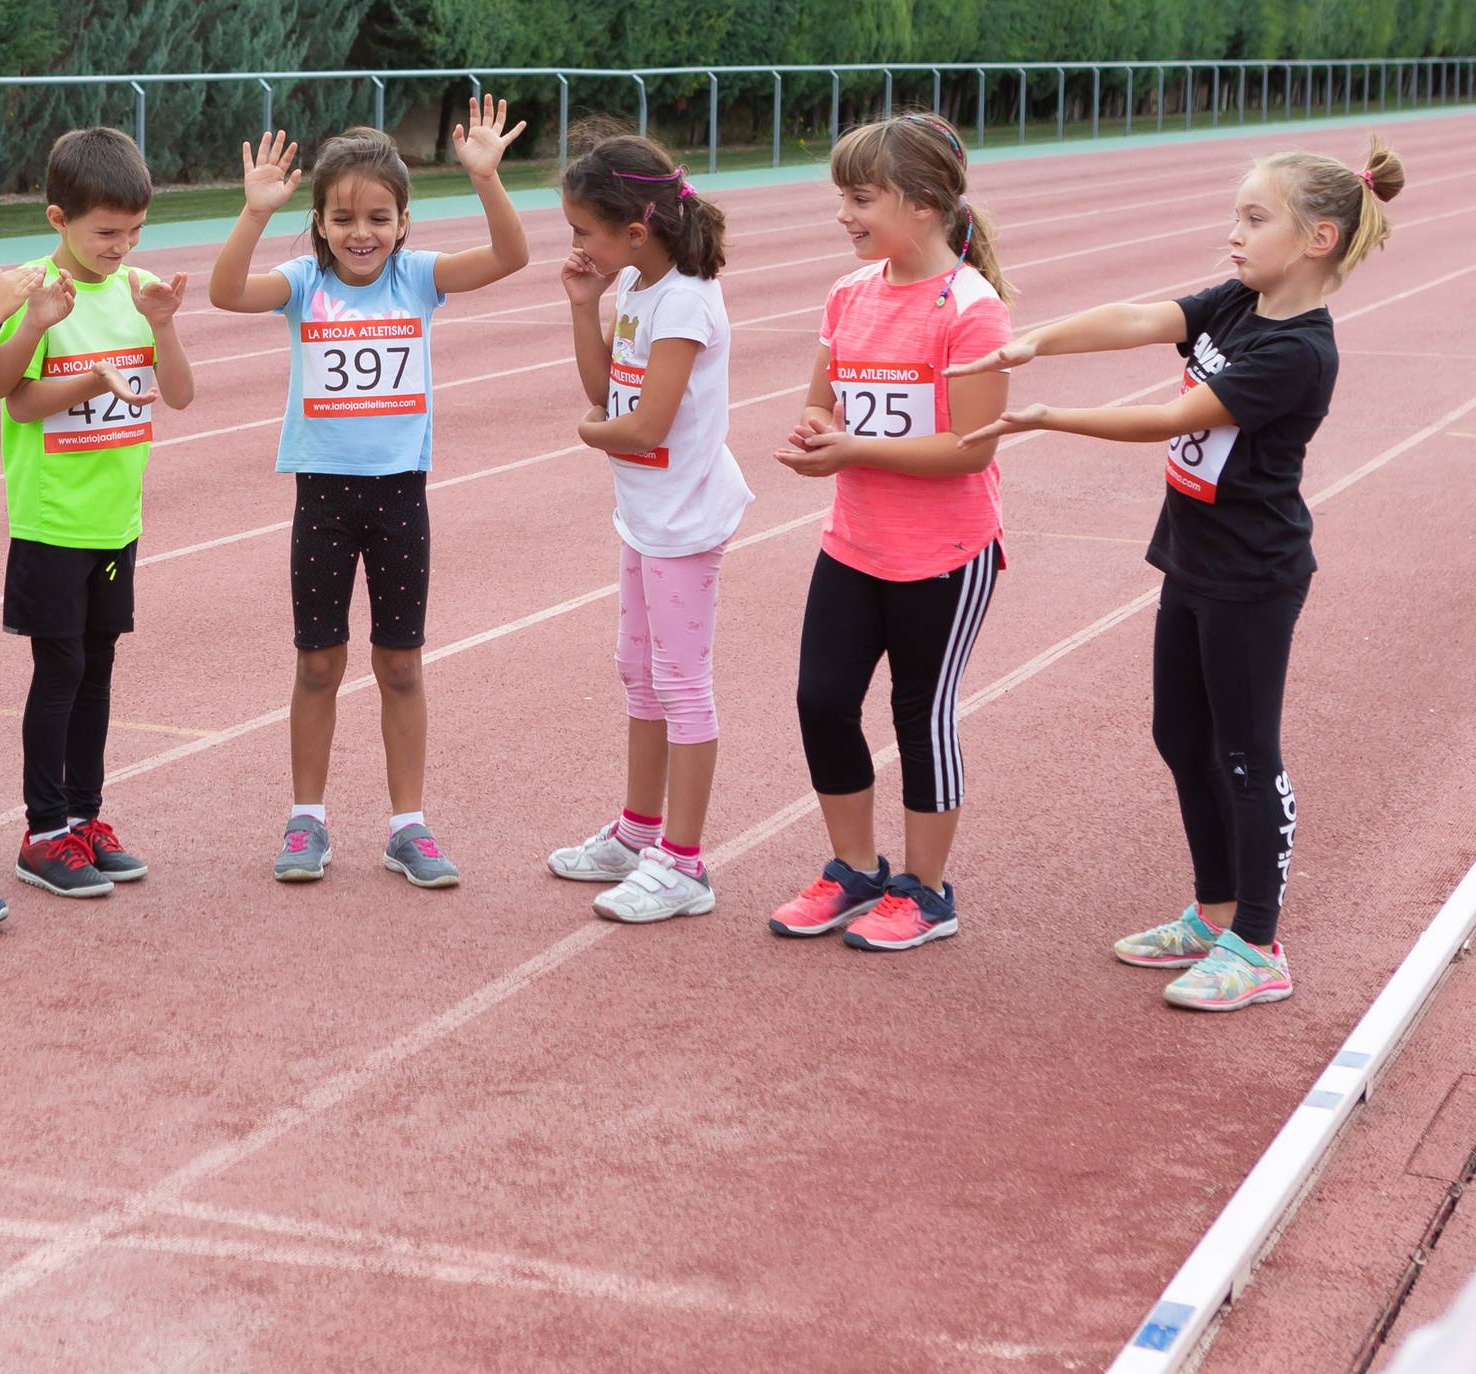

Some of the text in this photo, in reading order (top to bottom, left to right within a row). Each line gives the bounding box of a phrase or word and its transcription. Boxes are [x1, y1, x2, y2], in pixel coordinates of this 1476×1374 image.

[307, 324, 415, 340] LA RIOJA ATLETISMO
[47, 364, 61, 374] LA
[323, 347, 411, 392] 397
[860, 368, 920, 381] ATLETISMO
[313, 399, 416, 413] www.lariojaatletismo.com
